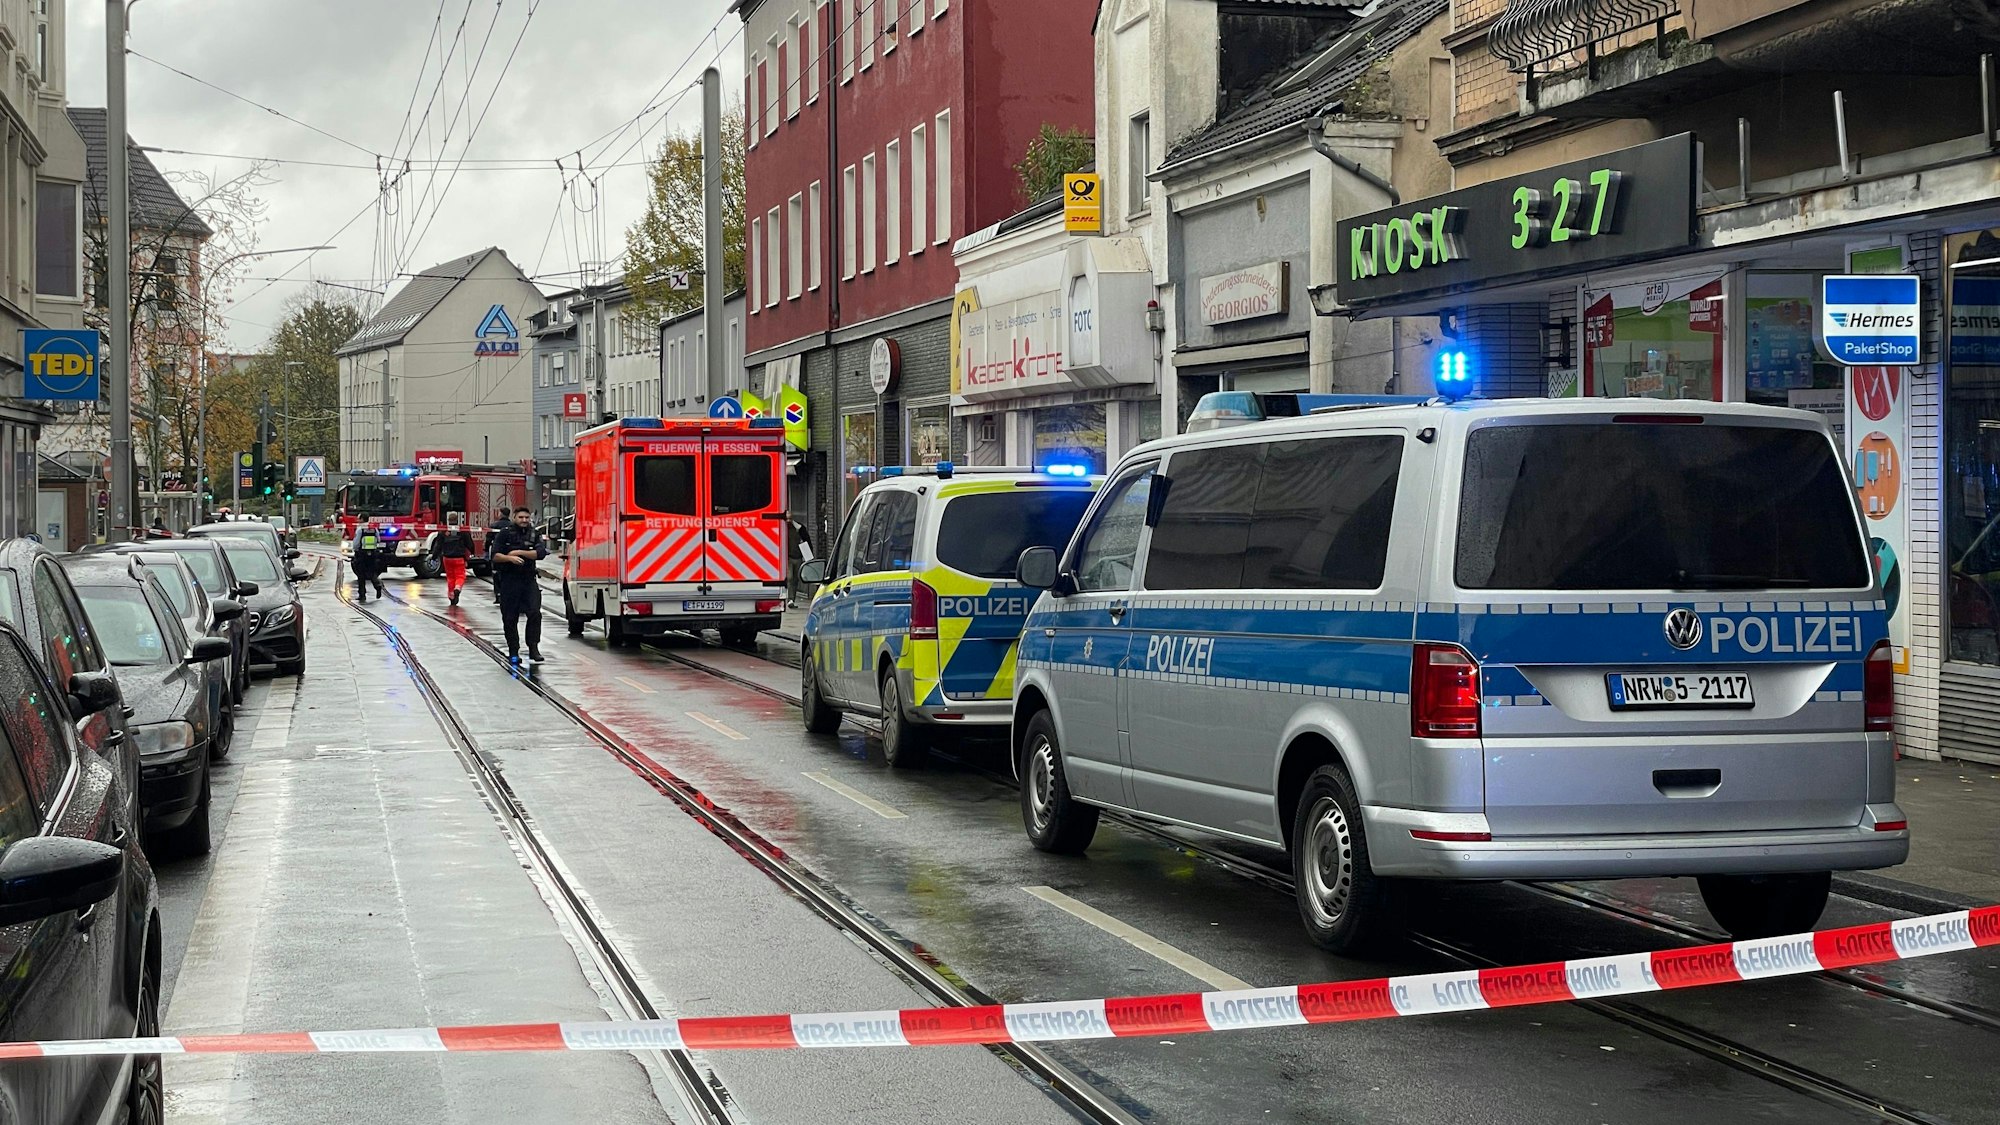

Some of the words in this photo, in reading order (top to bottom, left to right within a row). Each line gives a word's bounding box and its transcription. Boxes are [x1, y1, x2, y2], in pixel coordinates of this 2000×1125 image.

[1351, 205, 1449, 281] KIOSK
[1646, 282, 1664, 296] ortel
[1209, 294, 1269, 321] GEORGIOS
[1690, 300, 1711, 312] WORLD
[1850, 313, 1914, 328] Hermes
[475, 340, 519, 352] ALDI
[1845, 342, 1913, 357] PaketShop
[28, 353, 94, 376] TEDi
[648, 443, 720, 453] FEUERWEHR
[722, 443, 759, 453] ESSEN
[645, 517, 757, 529] RETTUNGSDIENST
[940, 596, 1029, 617] POLIZEI
[1710, 616, 1862, 654] POLIZEI
[1146, 634, 1215, 676] POLIZEI
[1614, 692, 1621, 700] D
[1623, 677, 1664, 701] NRW
[1675, 676, 1747, 700] 5-2117
